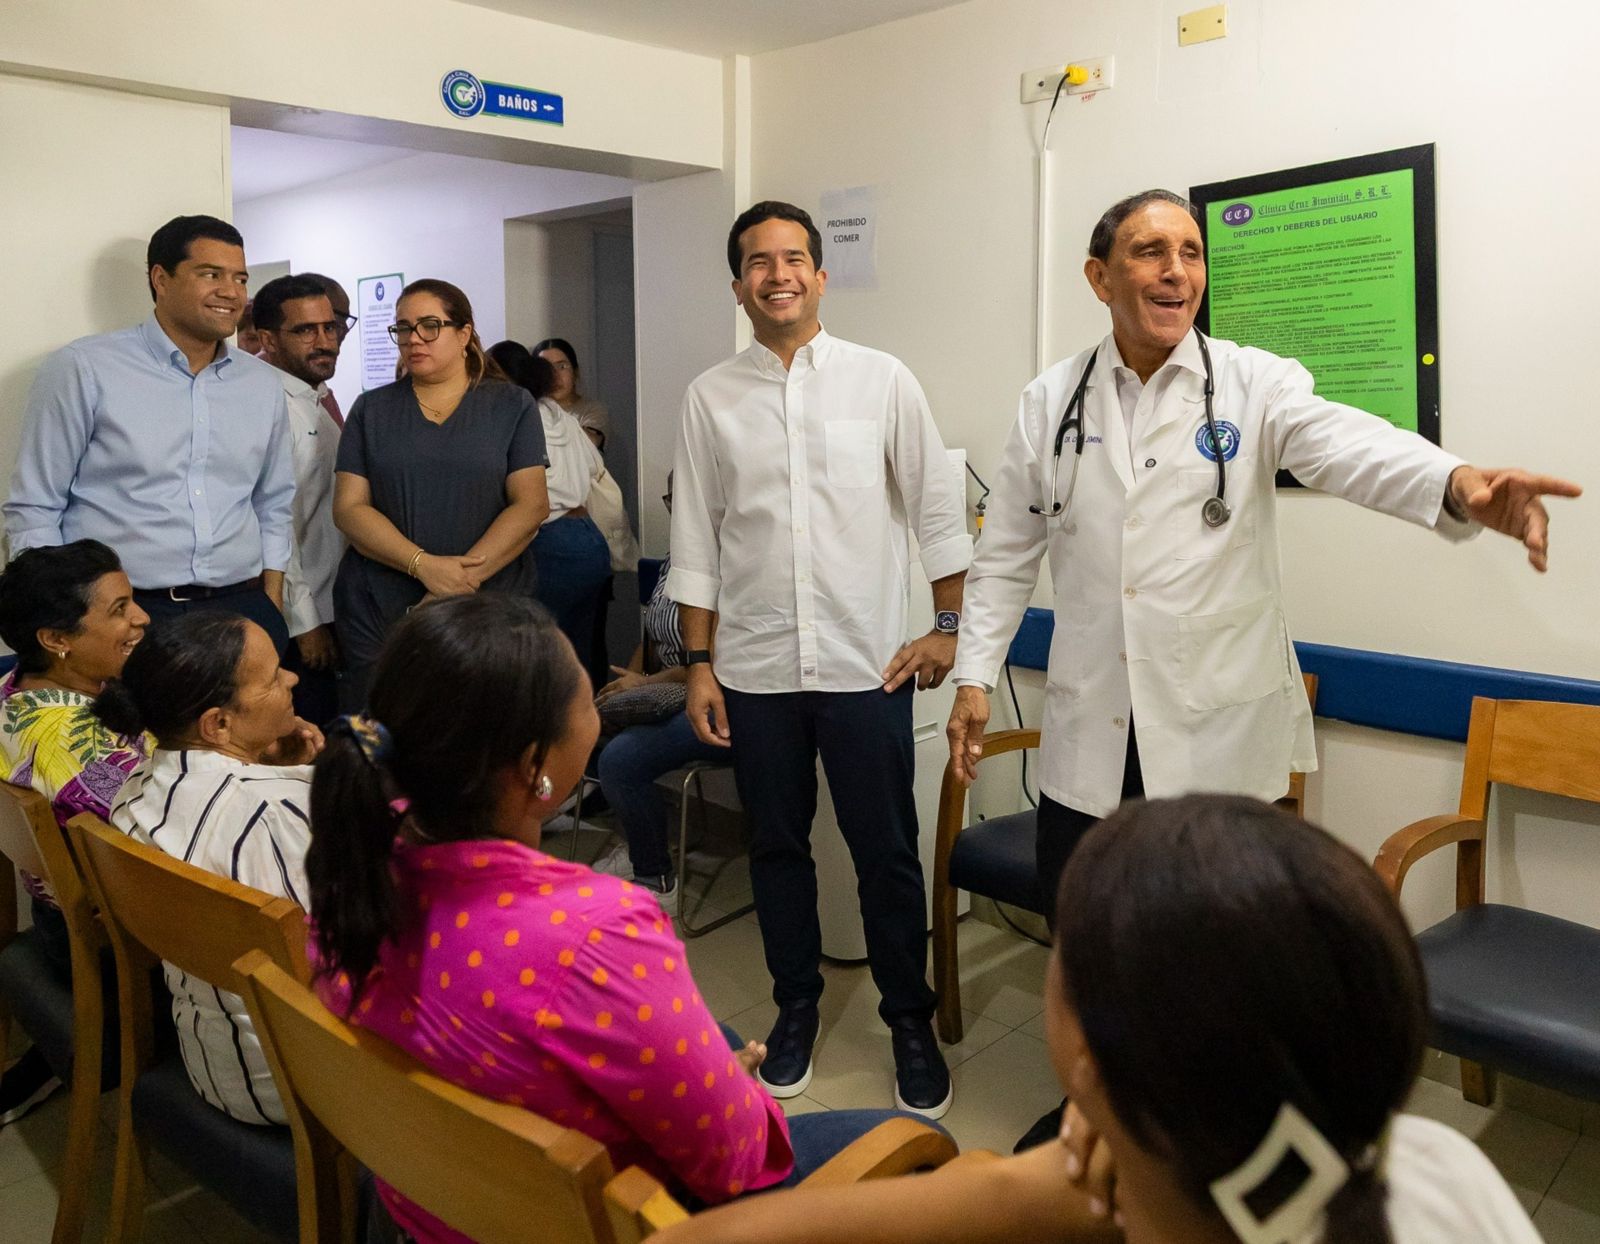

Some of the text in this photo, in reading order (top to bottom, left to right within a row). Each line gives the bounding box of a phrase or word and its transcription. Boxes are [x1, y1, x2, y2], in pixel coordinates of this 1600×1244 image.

[498, 94, 538, 112] BAÑOS
[827, 217, 867, 228] PROHIBIDO
[1233, 226, 1275, 238] DERECHOS
[1283, 219, 1321, 232] DEBERES
[1322, 217, 1338, 225] DEL
[1340, 211, 1378, 223] USUARIO
[833, 233, 860, 243] COMER
